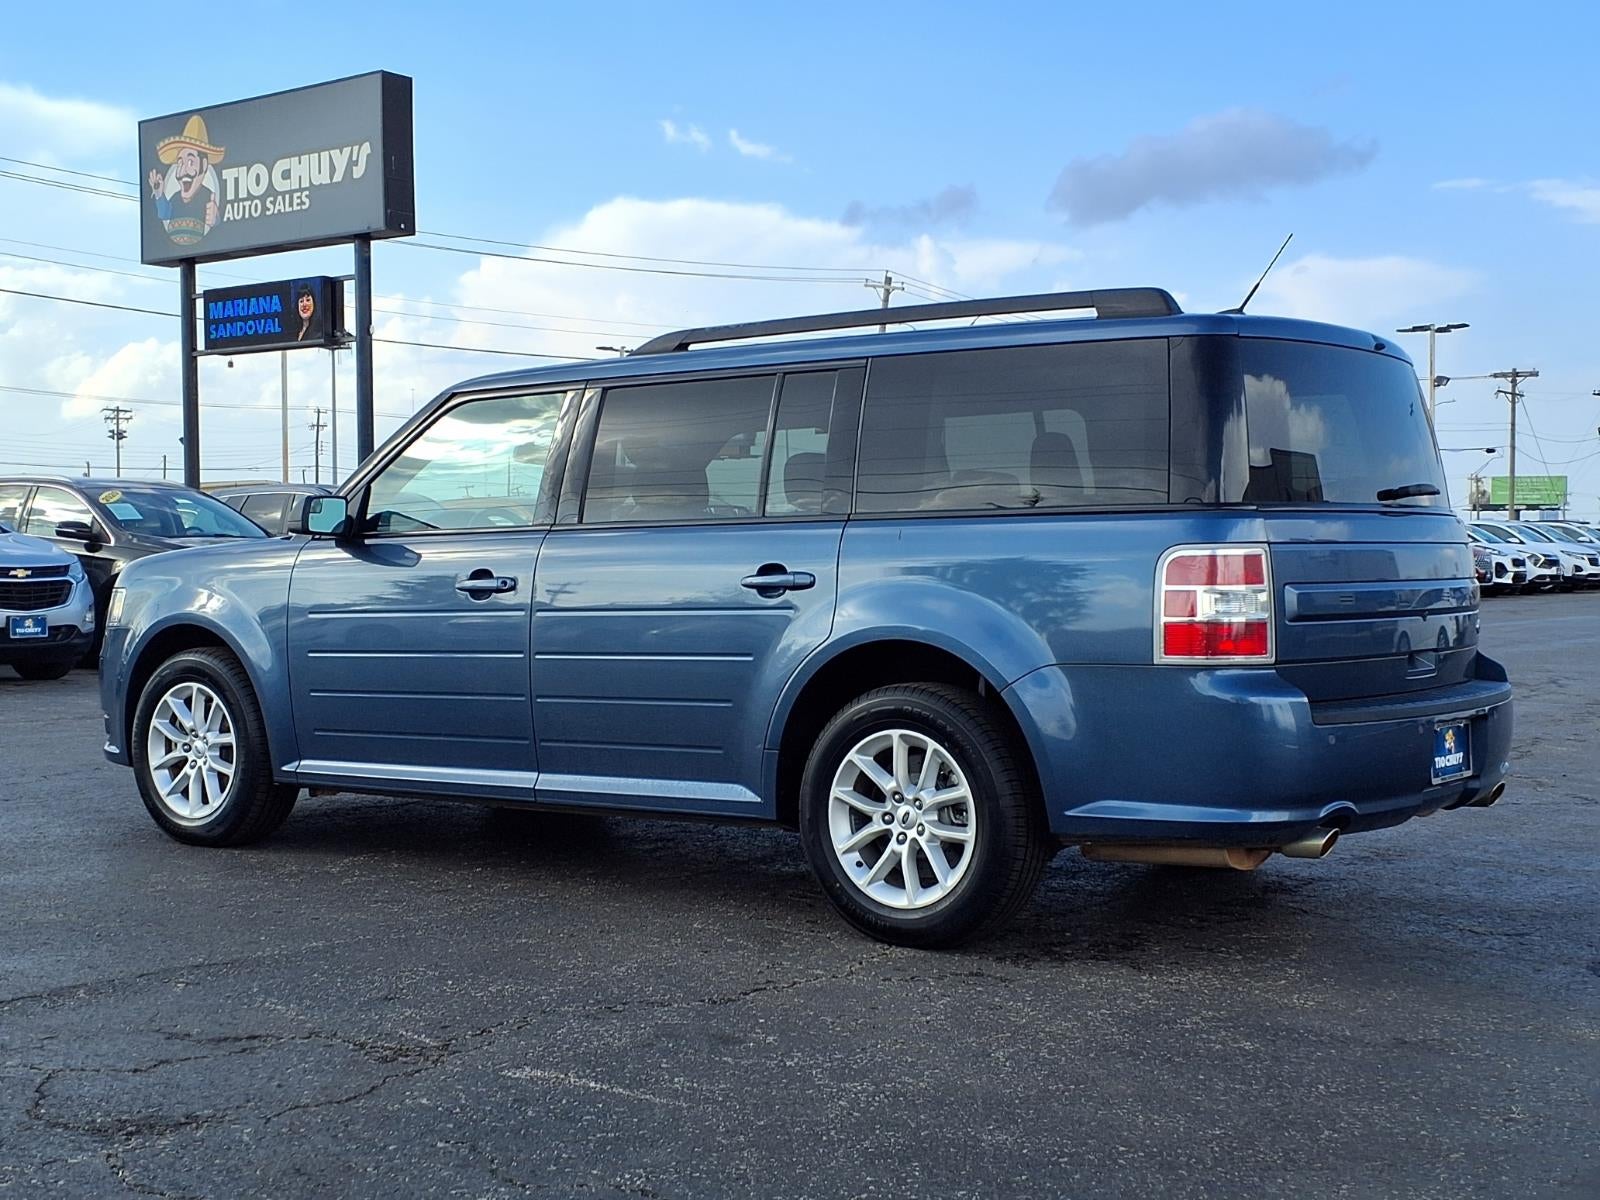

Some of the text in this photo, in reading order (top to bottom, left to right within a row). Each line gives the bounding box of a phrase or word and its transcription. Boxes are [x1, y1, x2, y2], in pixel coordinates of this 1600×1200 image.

[222, 141, 371, 200] TIO CHUY'S
[223, 191, 310, 222] AUTO SALES
[209, 295, 282, 319] MARIANA
[209, 318, 282, 339] SANDOVAL
